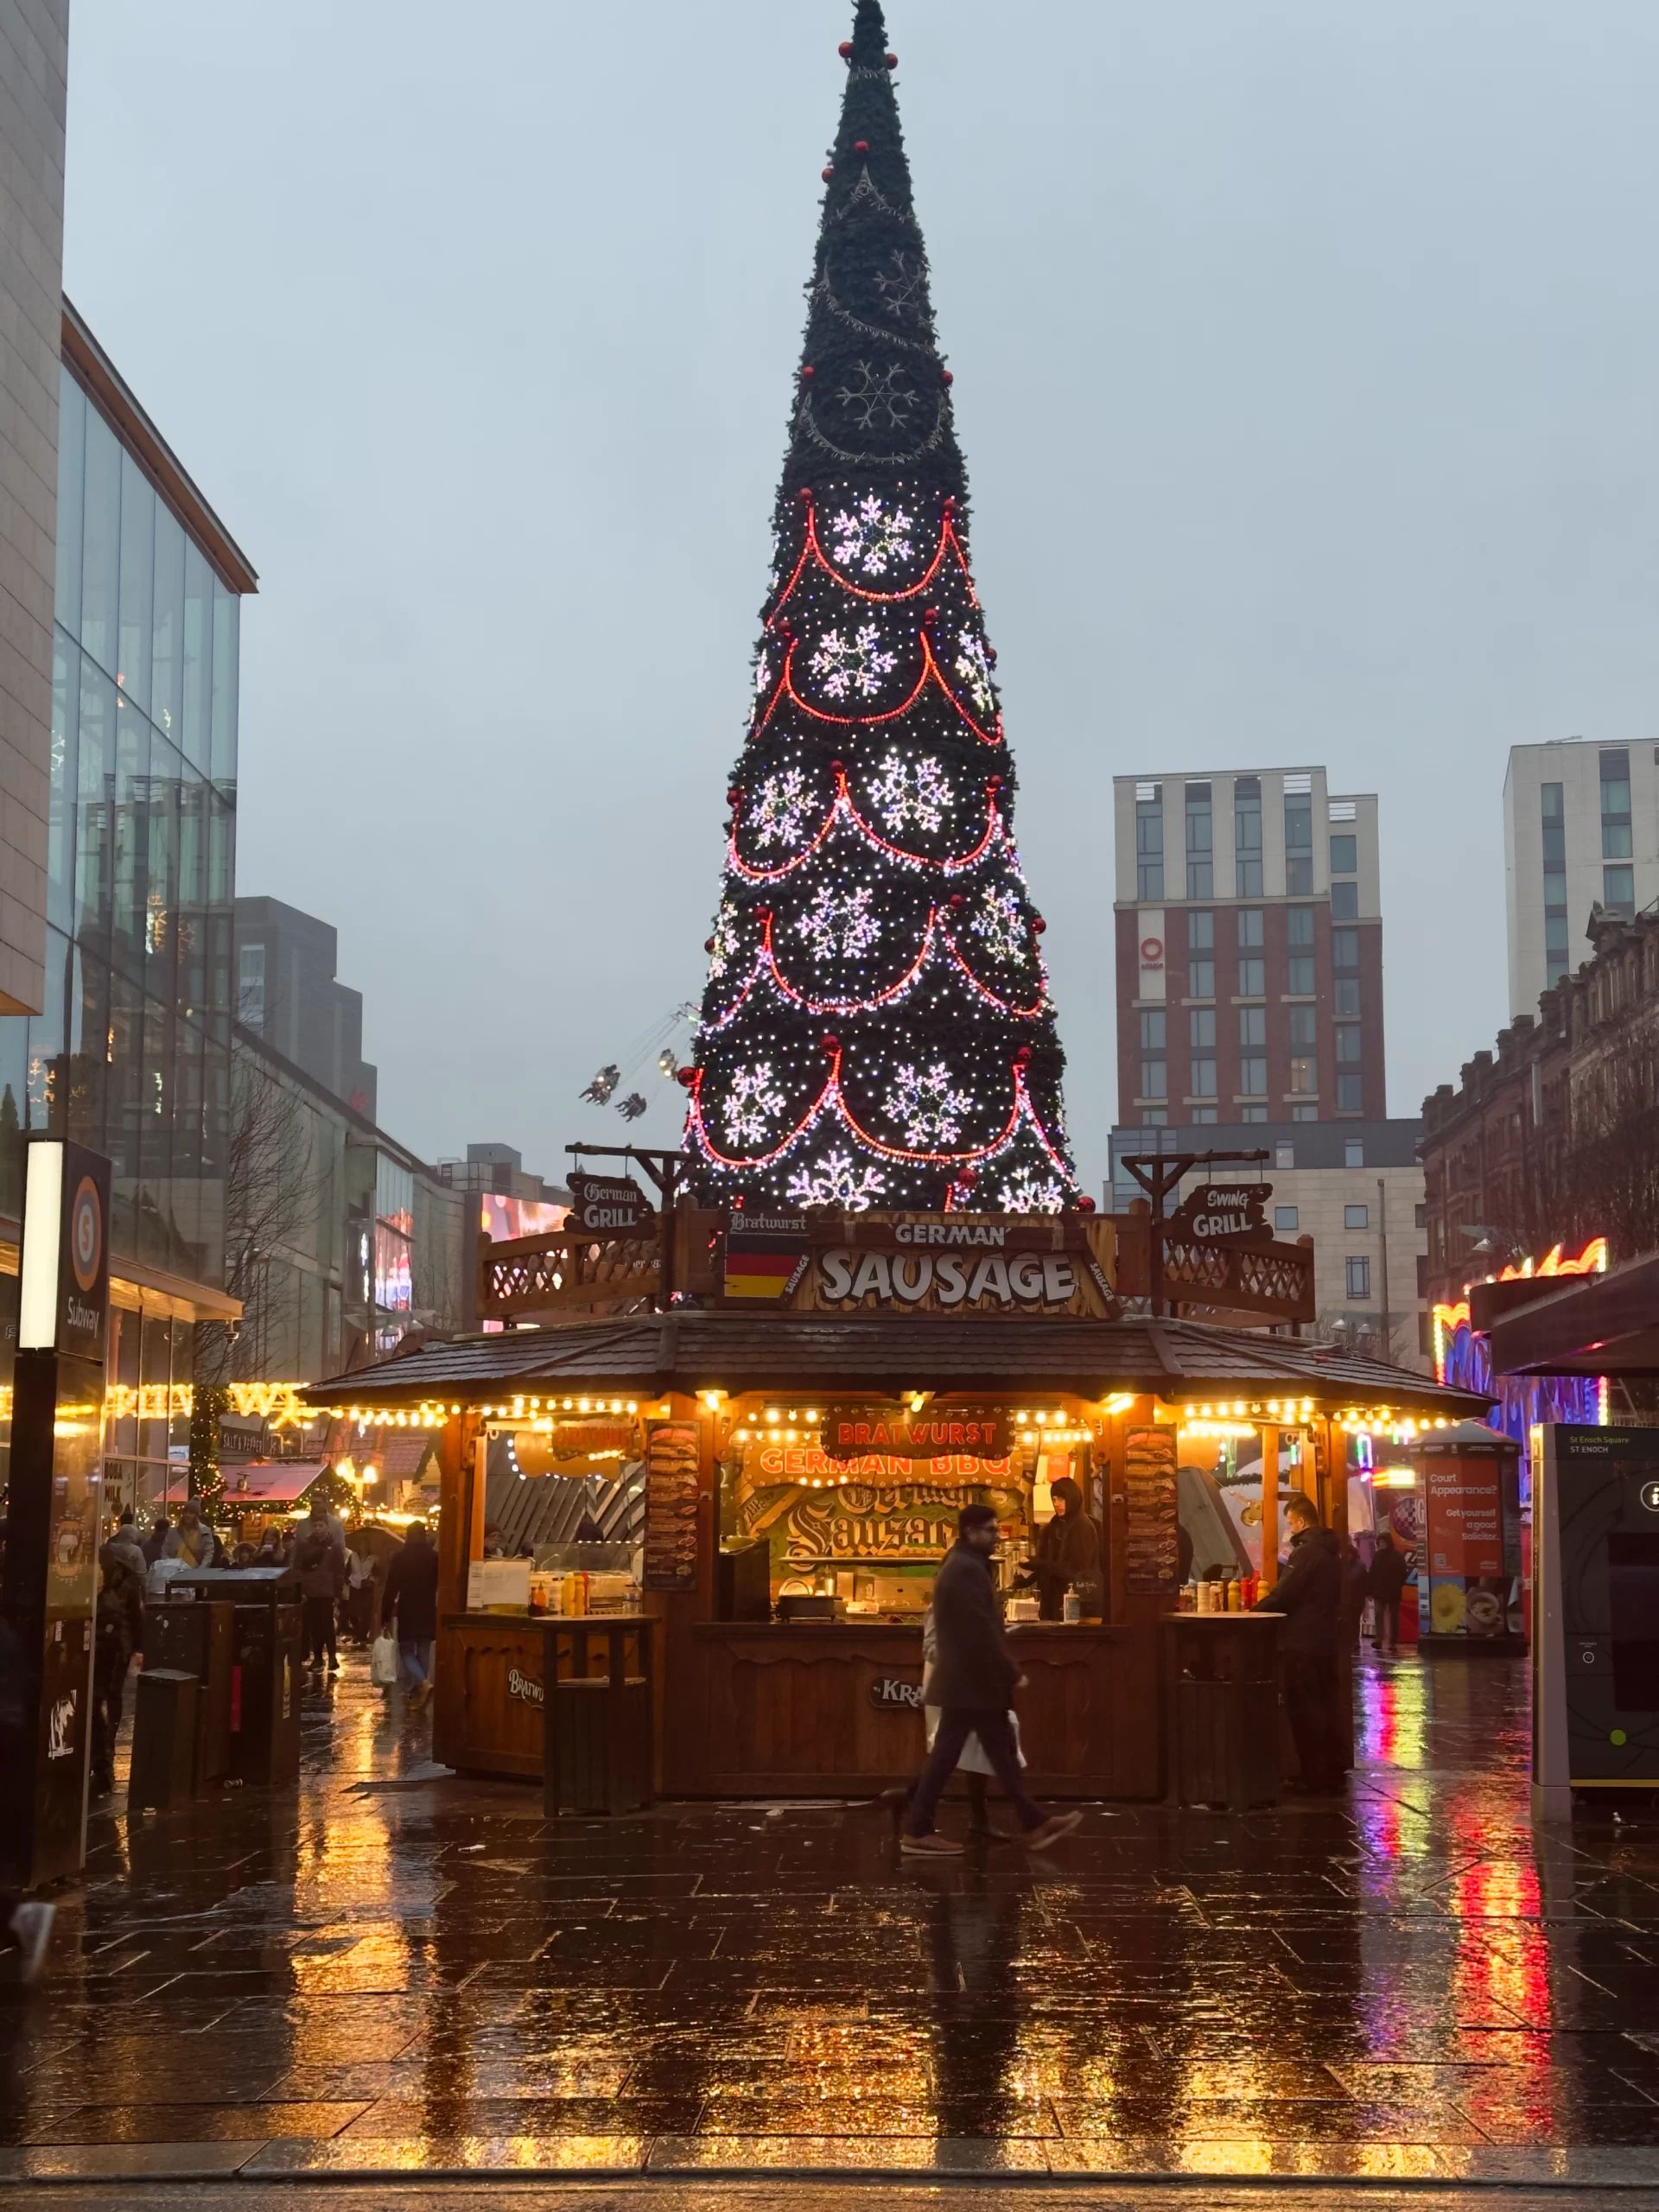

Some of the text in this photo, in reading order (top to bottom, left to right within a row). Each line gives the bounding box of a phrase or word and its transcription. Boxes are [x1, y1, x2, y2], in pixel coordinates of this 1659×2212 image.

[583, 1182, 638, 1203] German
[1207, 1189, 1249, 1211] SWING
[583, 1205, 638, 1228] GRILL
[728, 1211, 807, 1233] Bratwurst
[1192, 1212, 1253, 1237] GRILL
[895, 1224, 1006, 1246] GERMAN
[785, 1255, 810, 1294] SAUSAGE
[822, 1250, 1077, 1304] SAUSAGE
[1089, 1262, 1115, 1302] SAUSAGE
[67, 1296, 100, 1339] Subway
[837, 1422, 997, 1446] BRATWURST
[1580, 1435, 1602, 1444] Enoch
[1603, 1435, 1630, 1445] Square
[930, 1453, 1012, 1477] BBQ
[1430, 1473, 1458, 1483] Court
[1430, 1485, 1497, 1497] Appearance?
[1446, 1509, 1497, 1519] Get yourself
[1461, 1532, 1500, 1541] Solicitor.
[1474, 1521, 1497, 1530] good
